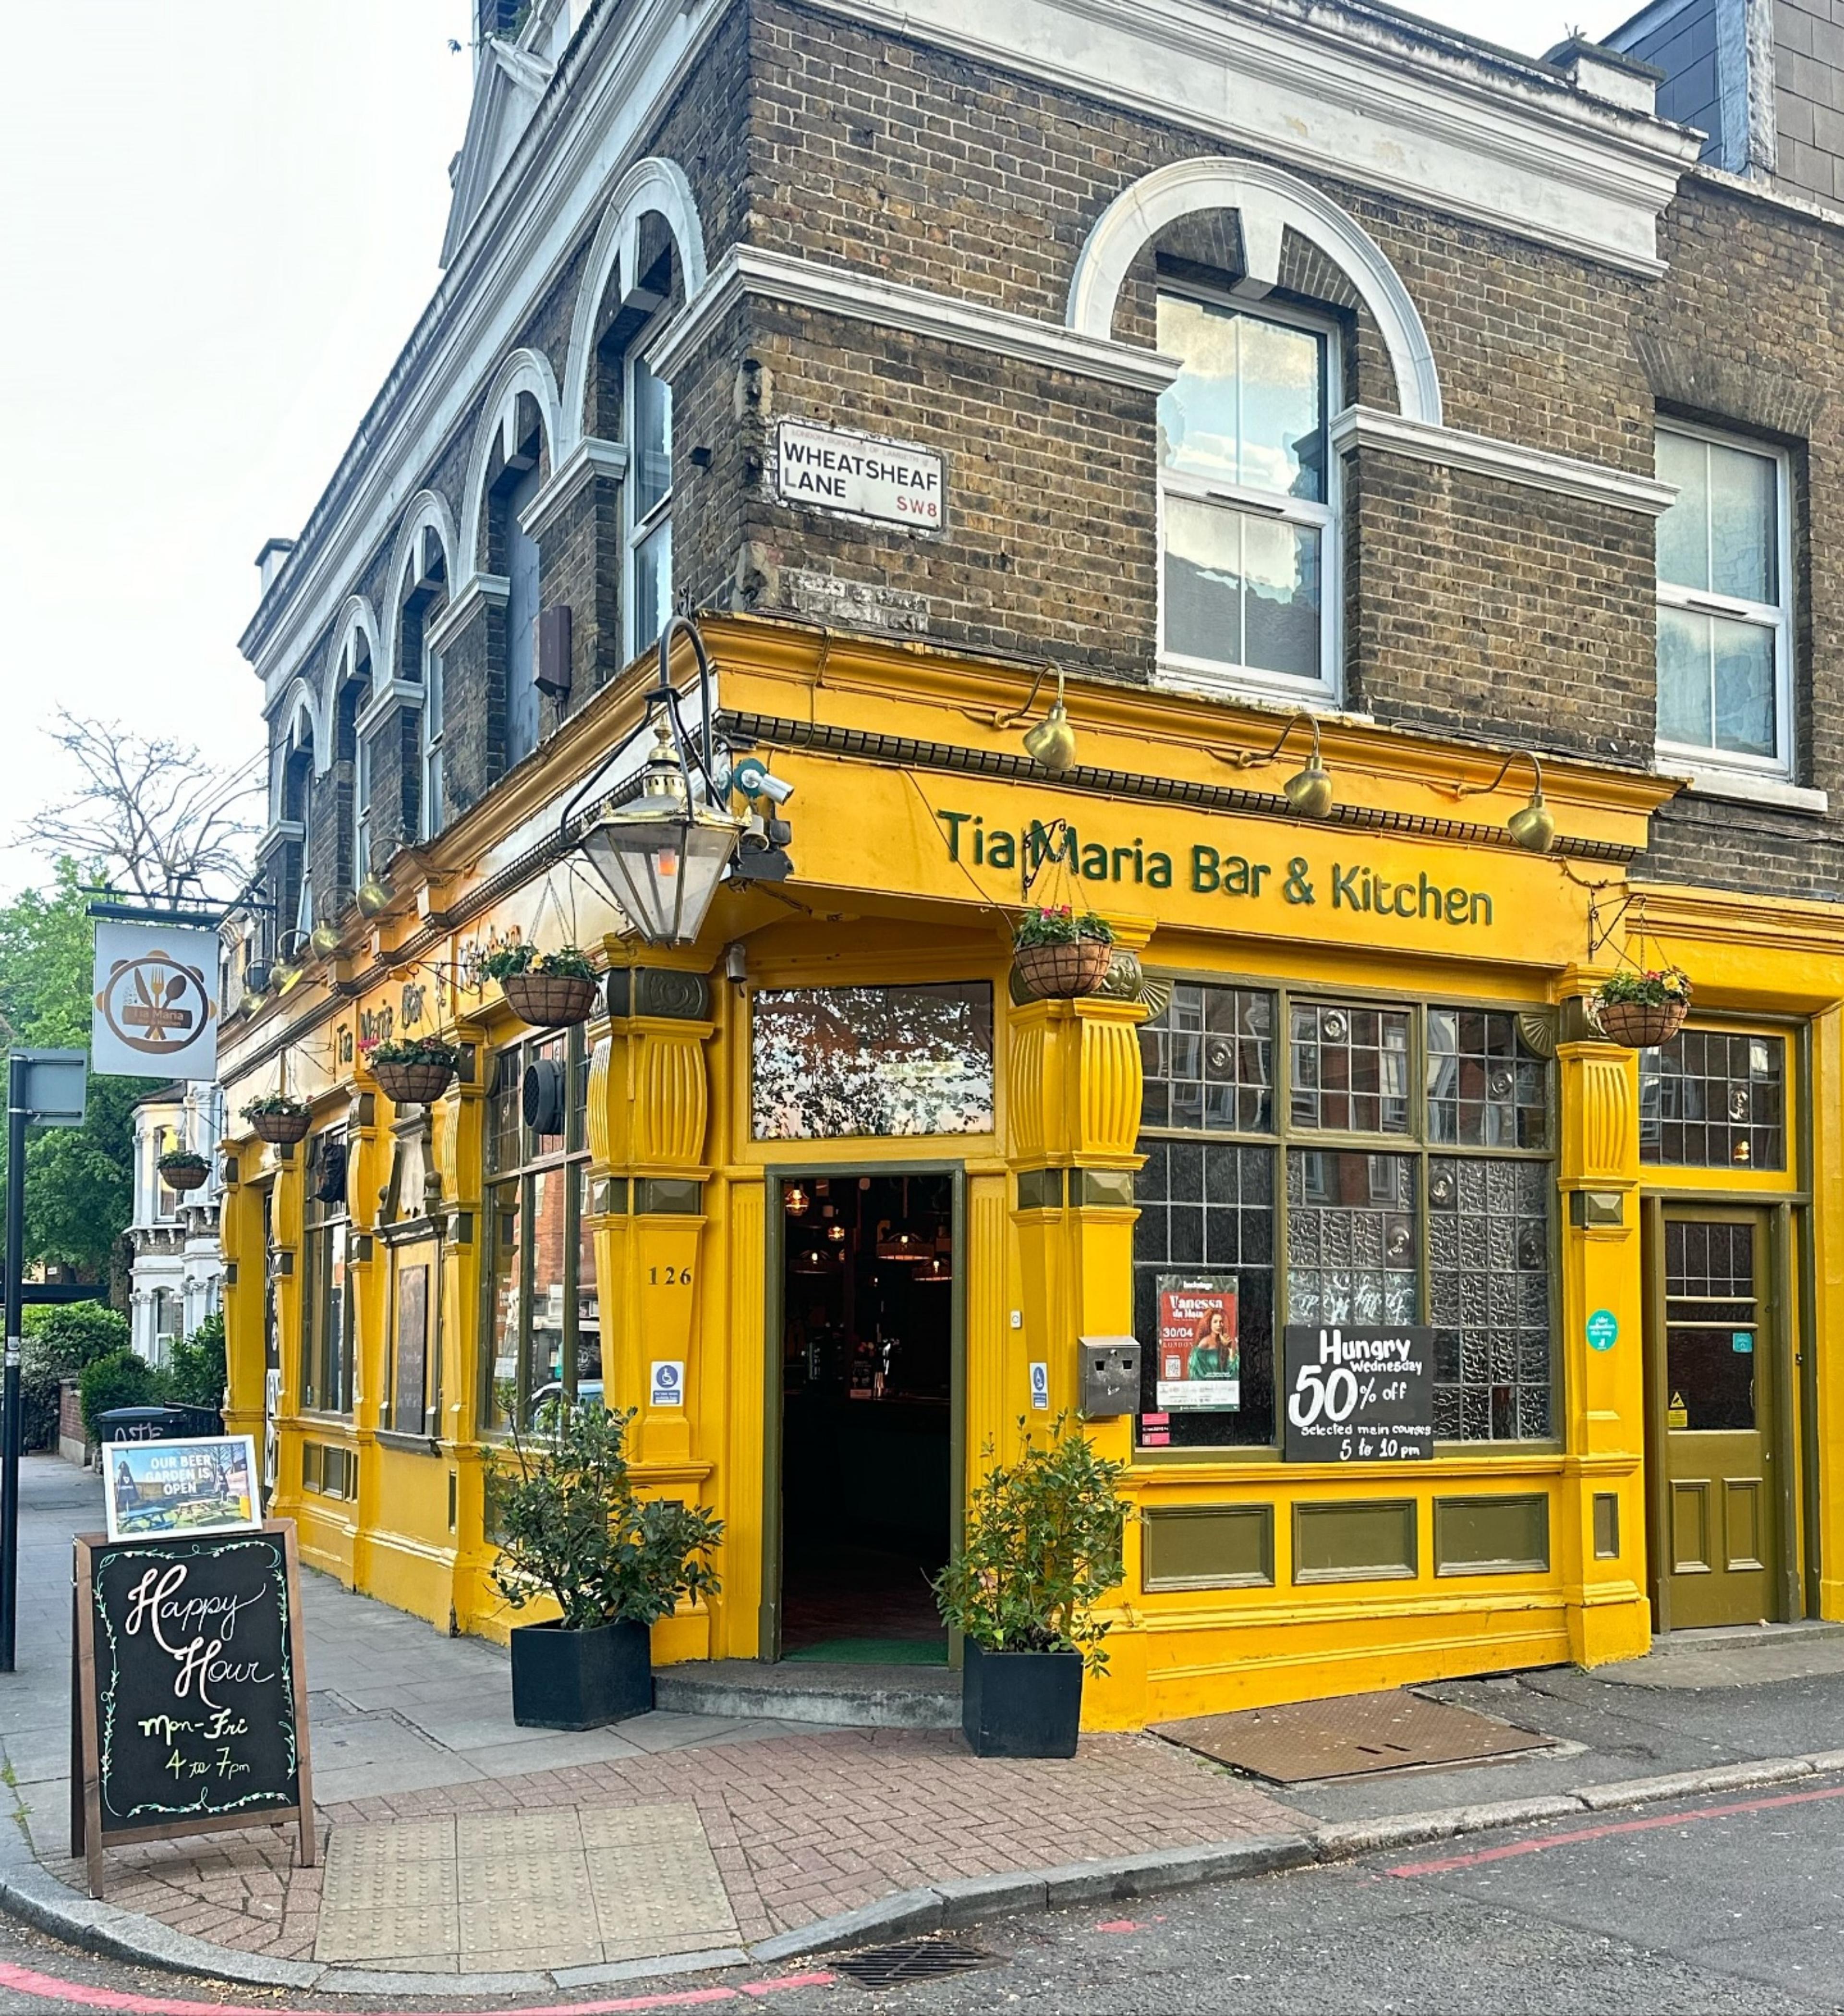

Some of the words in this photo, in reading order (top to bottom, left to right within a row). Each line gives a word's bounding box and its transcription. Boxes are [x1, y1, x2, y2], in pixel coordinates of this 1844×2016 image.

[784, 441, 938, 491] WHEATSHEAF
[785, 467, 846, 498] LANE
[897, 496, 937, 517] SW8
[937, 809, 1015, 869] Tia
[1030, 818, 1172, 887] Maria
[1191, 844, 1271, 897] Bar
[1284, 856, 1316, 905] &
[1332, 862, 1493, 926] Kitchen
[152, 1008, 184, 1020] Maria
[648, 1266, 692, 1285] 126
[1169, 1295, 1223, 1309] Vanessa
[1163, 1327, 1194, 1337] 30/04
[1320, 1329, 1411, 1365] Hungry
[1350, 1360, 1422, 1376] Wednesday
[1382, 1382, 1407, 1401] off
[1357, 1423, 1389, 1435] main
[1392, 1424, 1432, 1436] courses
[1339, 1438, 1352, 1461] 5
[1359, 1437, 1374, 1456] to
[151, 1455, 177, 1469] OUR
[180, 1454, 211, 1468] BEER
[145, 1468, 195, 1482] GARDEN
[198, 1467, 210, 1479] IS
[163, 1482, 196, 1495] OPEN
[125, 1564, 266, 1654] Happy
[173, 1637, 275, 1709] Hour
[166, 1749, 187, 1780] 4
[188, 1761, 211, 1778] to
